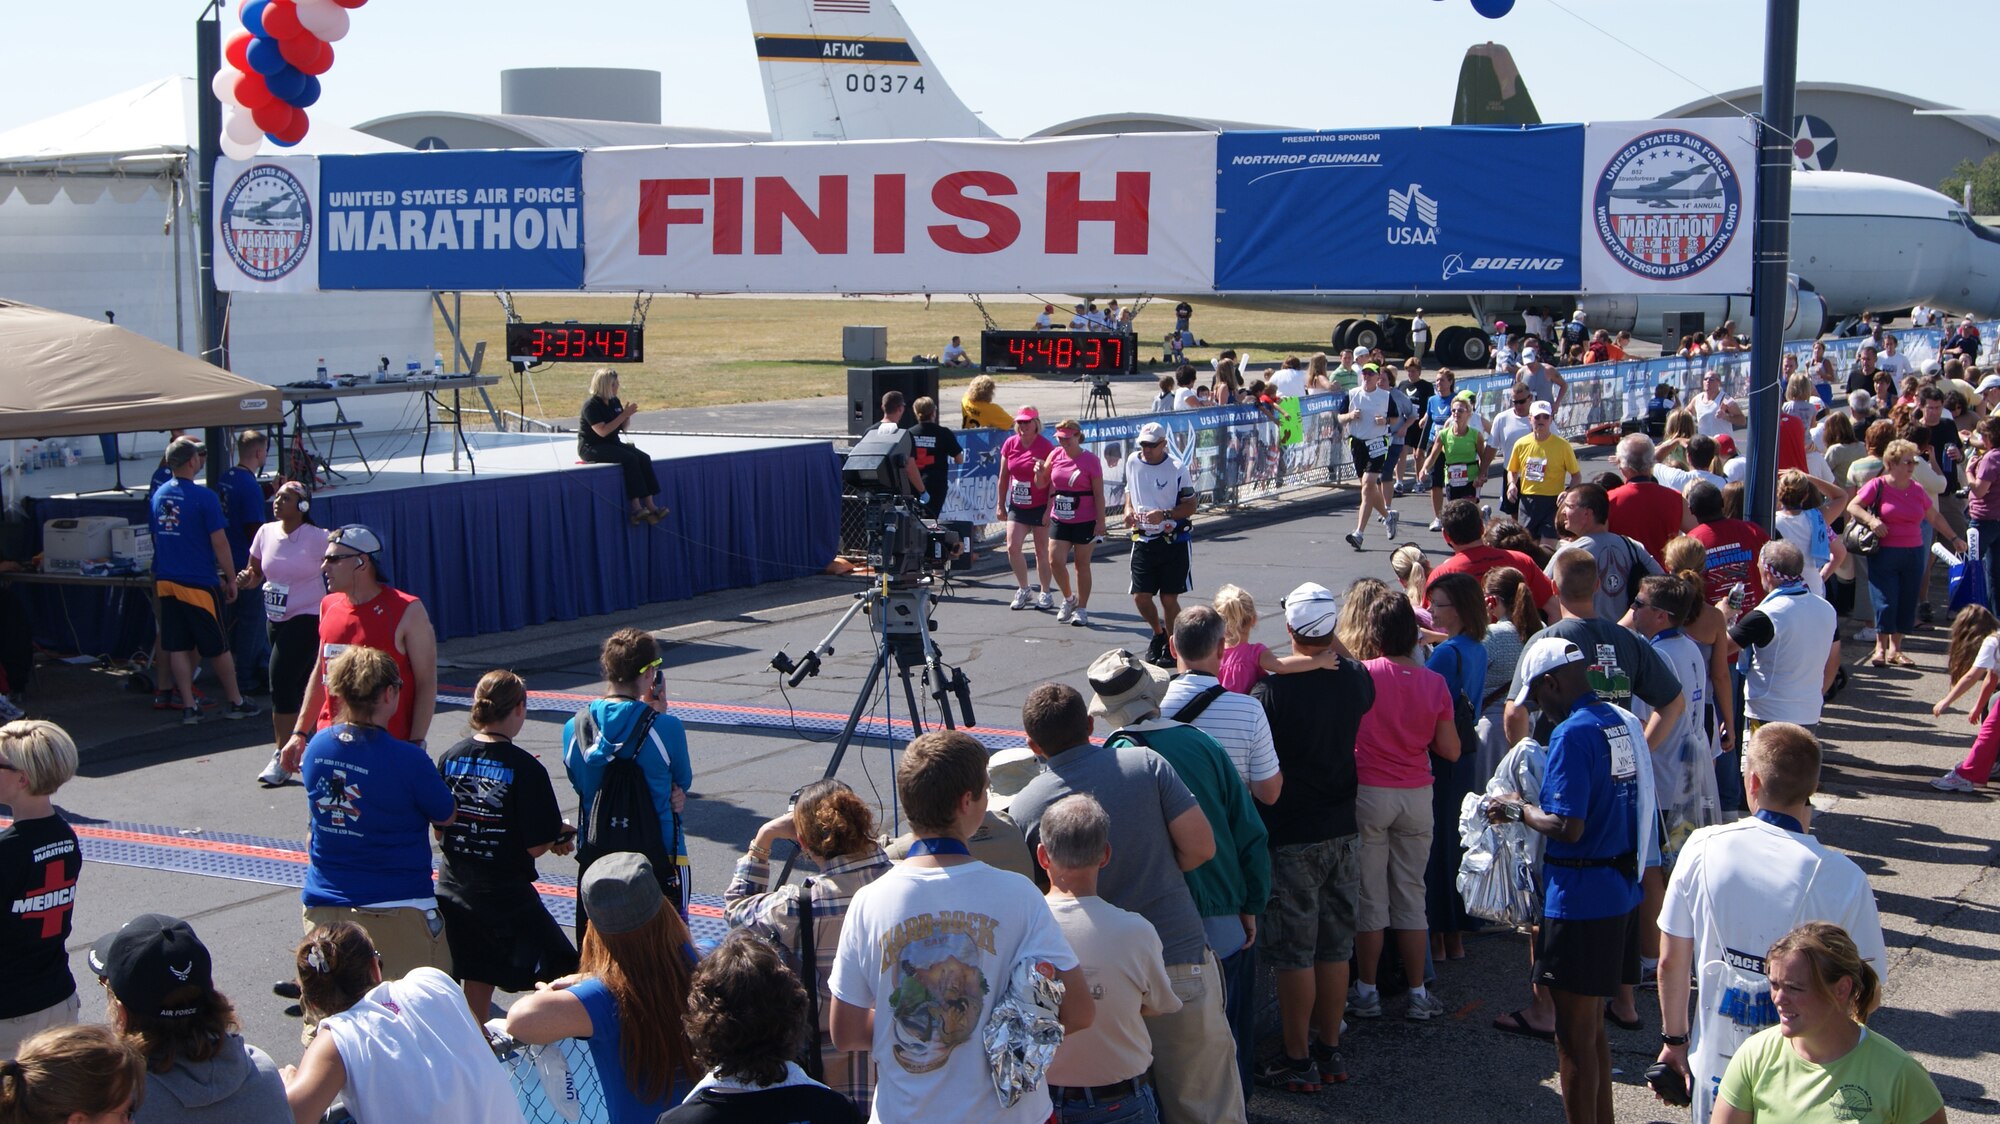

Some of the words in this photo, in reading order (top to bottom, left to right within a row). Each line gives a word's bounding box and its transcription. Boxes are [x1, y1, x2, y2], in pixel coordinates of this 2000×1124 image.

[823, 42, 865, 57] AFMC
[846, 74, 925, 94] 00374
[1282, 134, 1336, 144] PRESENTING
[1338, 133, 1381, 142] SPONSOR
[1232, 154, 1307, 165] NORTHROP
[1308, 153, 1381, 164] GRUMMAN
[1606, 146, 1638, 181] UNITED
[1640, 134, 1681, 149] STATES
[1682, 136, 1702, 151] AIR
[1702, 146, 1731, 179] FORCE
[228, 175, 250, 203] UNITED
[250, 167, 276, 179] STATES
[276, 171, 289, 182] AIR
[288, 176, 306, 204] FORCE
[329, 191, 396, 207] UNITED
[401, 189, 468, 206] STATES
[473, 188, 508, 204] AIR
[514, 187, 576, 203] FORCE
[638, 170, 1151, 255] FINISH
[328, 207, 578, 251] MARATHON
[1387, 227, 1437, 245] USAA
[1620, 217, 1714, 238] MARATHON
[237, 231, 296, 249] MARATHON
[1597, 206, 1666, 275] WRIGHT-PATTERSON
[1668, 263, 1689, 275] AFB
[1695, 231, 1731, 267] DAYTON,
[1725, 203, 1738, 230] OHIO
[1632, 240, 1656, 248] HALF
[1663, 239, 1680, 248] 10K
[1688, 239, 1699, 247] 5K
[1470, 257, 1564, 270] BOEING
[267, 268, 280, 278] AFB
[34, 844, 75, 863] MARATHON
[939, 911, 1000, 956] ROCK
[1726, 953, 1760, 971] PACE
[175, 1008, 197, 1016] FORCE
